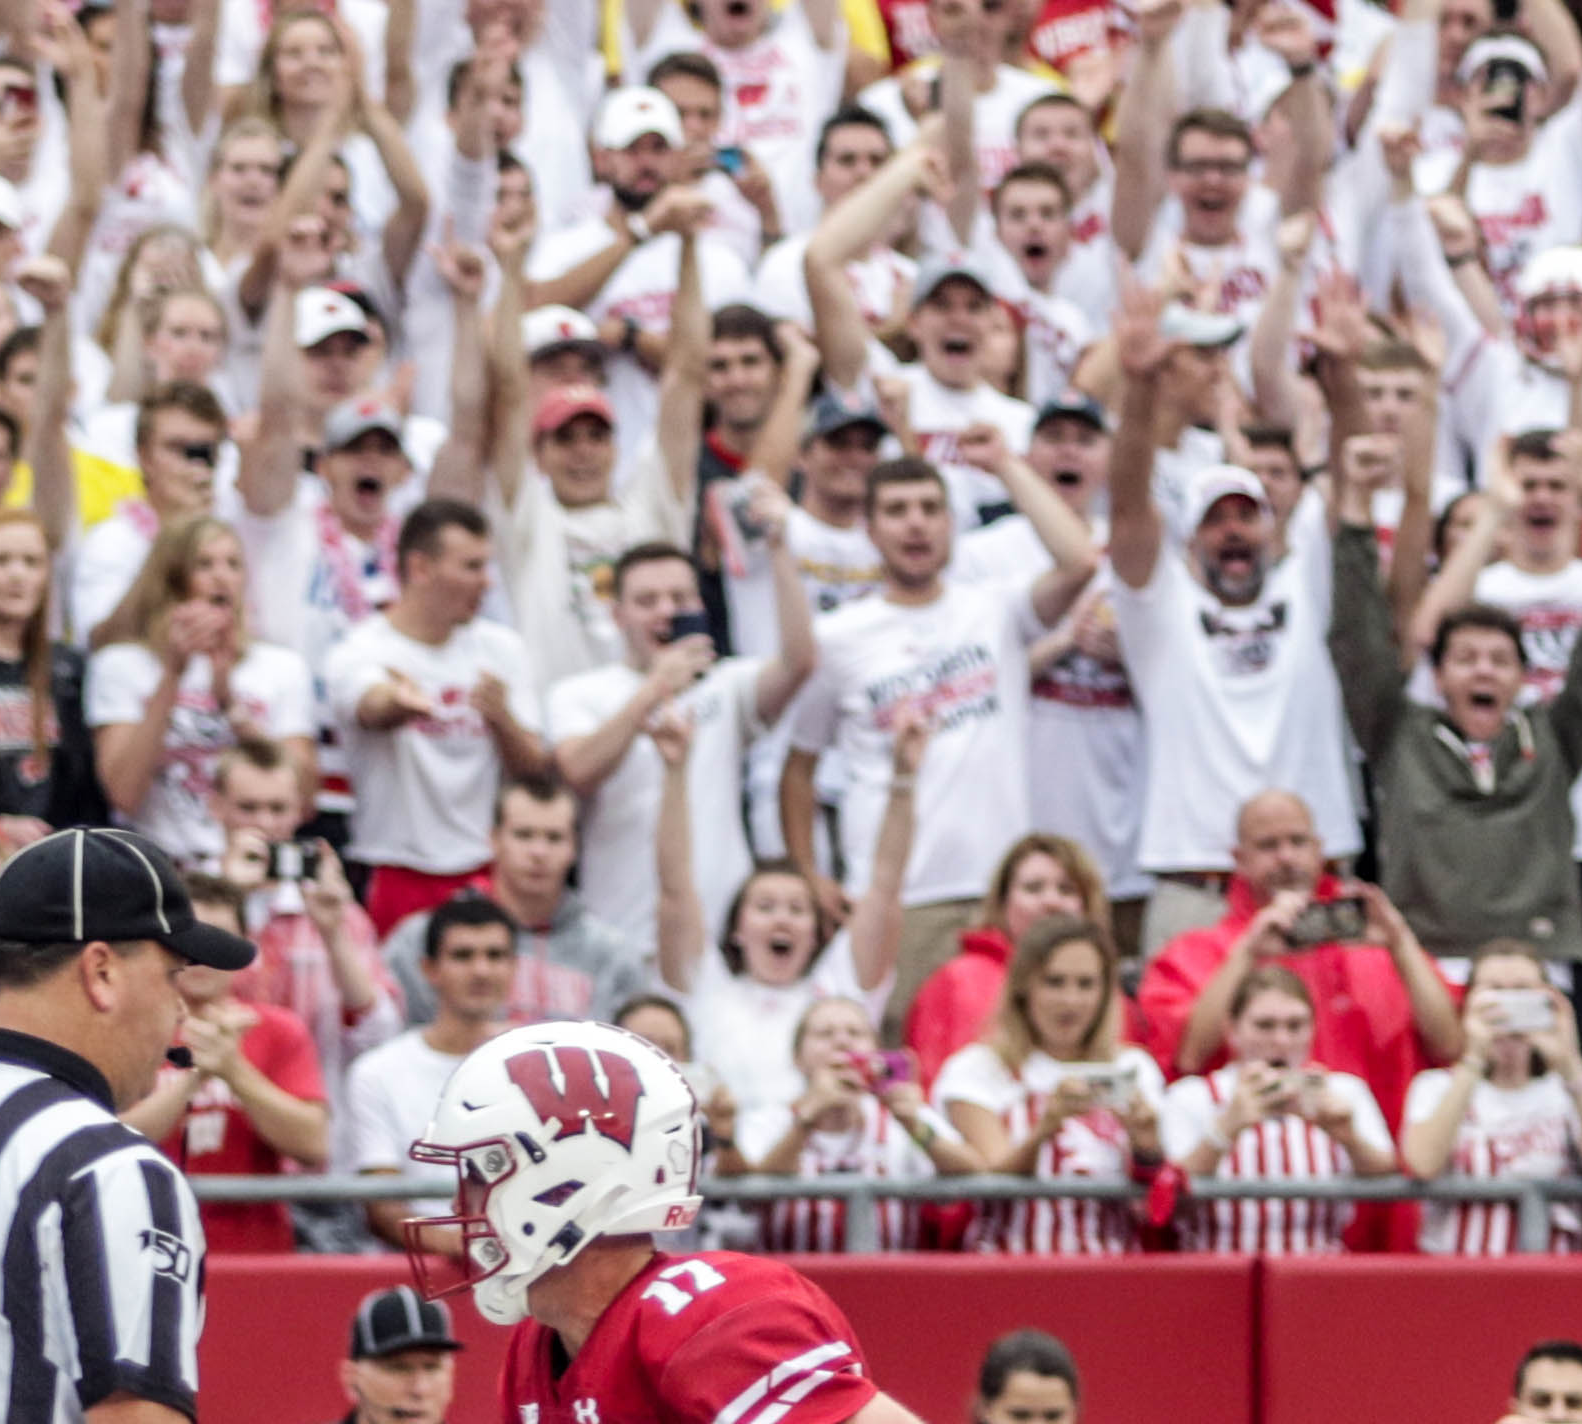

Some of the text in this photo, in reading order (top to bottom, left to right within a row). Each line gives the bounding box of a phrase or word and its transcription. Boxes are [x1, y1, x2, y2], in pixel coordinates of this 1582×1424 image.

[503, 1046, 647, 1155] W
[135, 1229, 191, 1282] 150
[640, 1258, 728, 1316] 17
